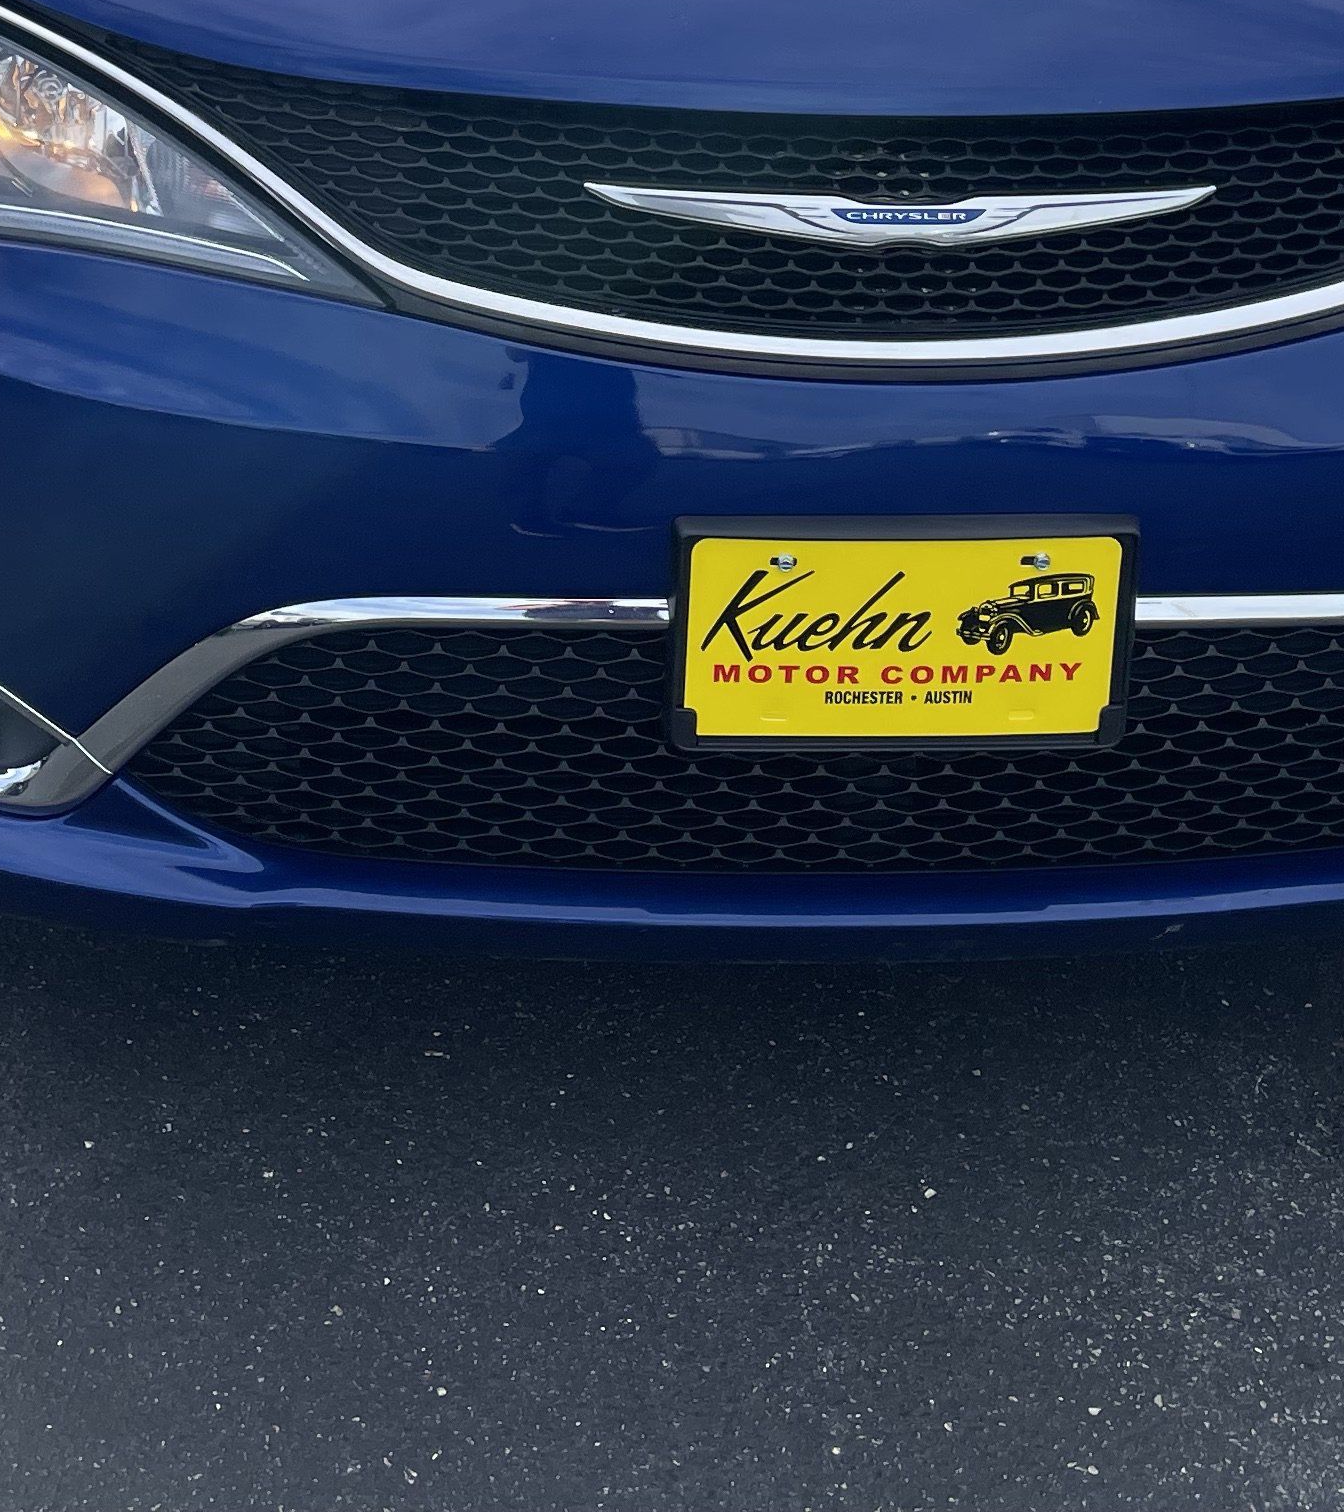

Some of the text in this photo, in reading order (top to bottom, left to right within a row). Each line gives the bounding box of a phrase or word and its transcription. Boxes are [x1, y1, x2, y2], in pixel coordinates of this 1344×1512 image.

[846, 211, 967, 221] CHRYSLER
[700, 570, 933, 663] Kuehn
[713, 662, 1083, 685] MOTOR COMPANY
[824, 690, 973, 705] ROCHESTER AUSTIN
